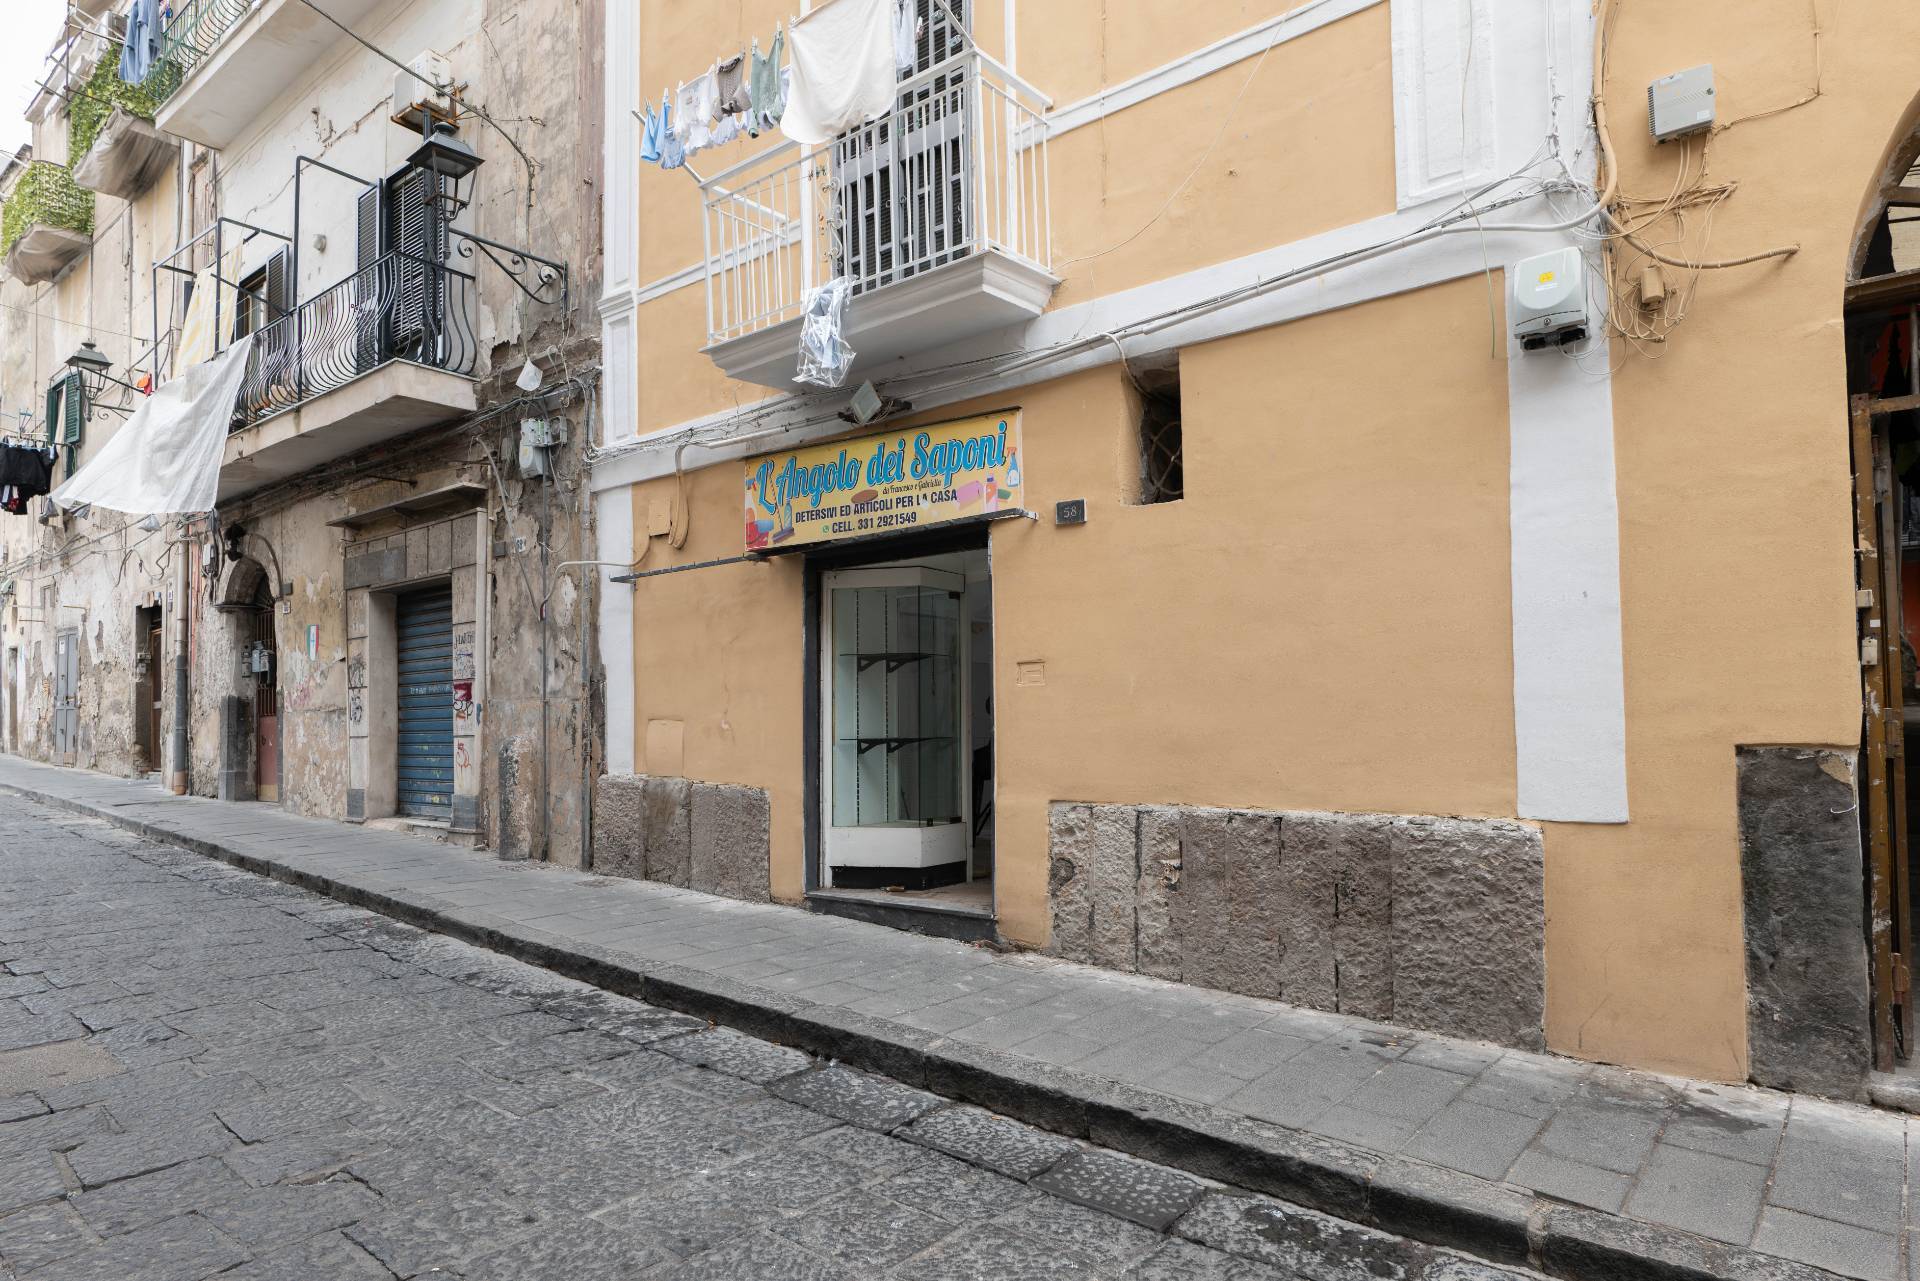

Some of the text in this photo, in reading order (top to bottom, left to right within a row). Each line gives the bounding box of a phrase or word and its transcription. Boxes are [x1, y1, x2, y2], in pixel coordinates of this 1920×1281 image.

[755, 420, 1007, 515] L'Angolo dei Saponi
[795, 505, 837, 523] DETERSIVI
[840, 506, 851, 516] ED
[853, 499, 893, 515] ARTICOLI
[896, 496, 914, 509] PER
[931, 489, 957, 503] CASA
[1063, 506, 1077, 519] 58
[832, 511, 917, 533] CELL. 331 2921549
